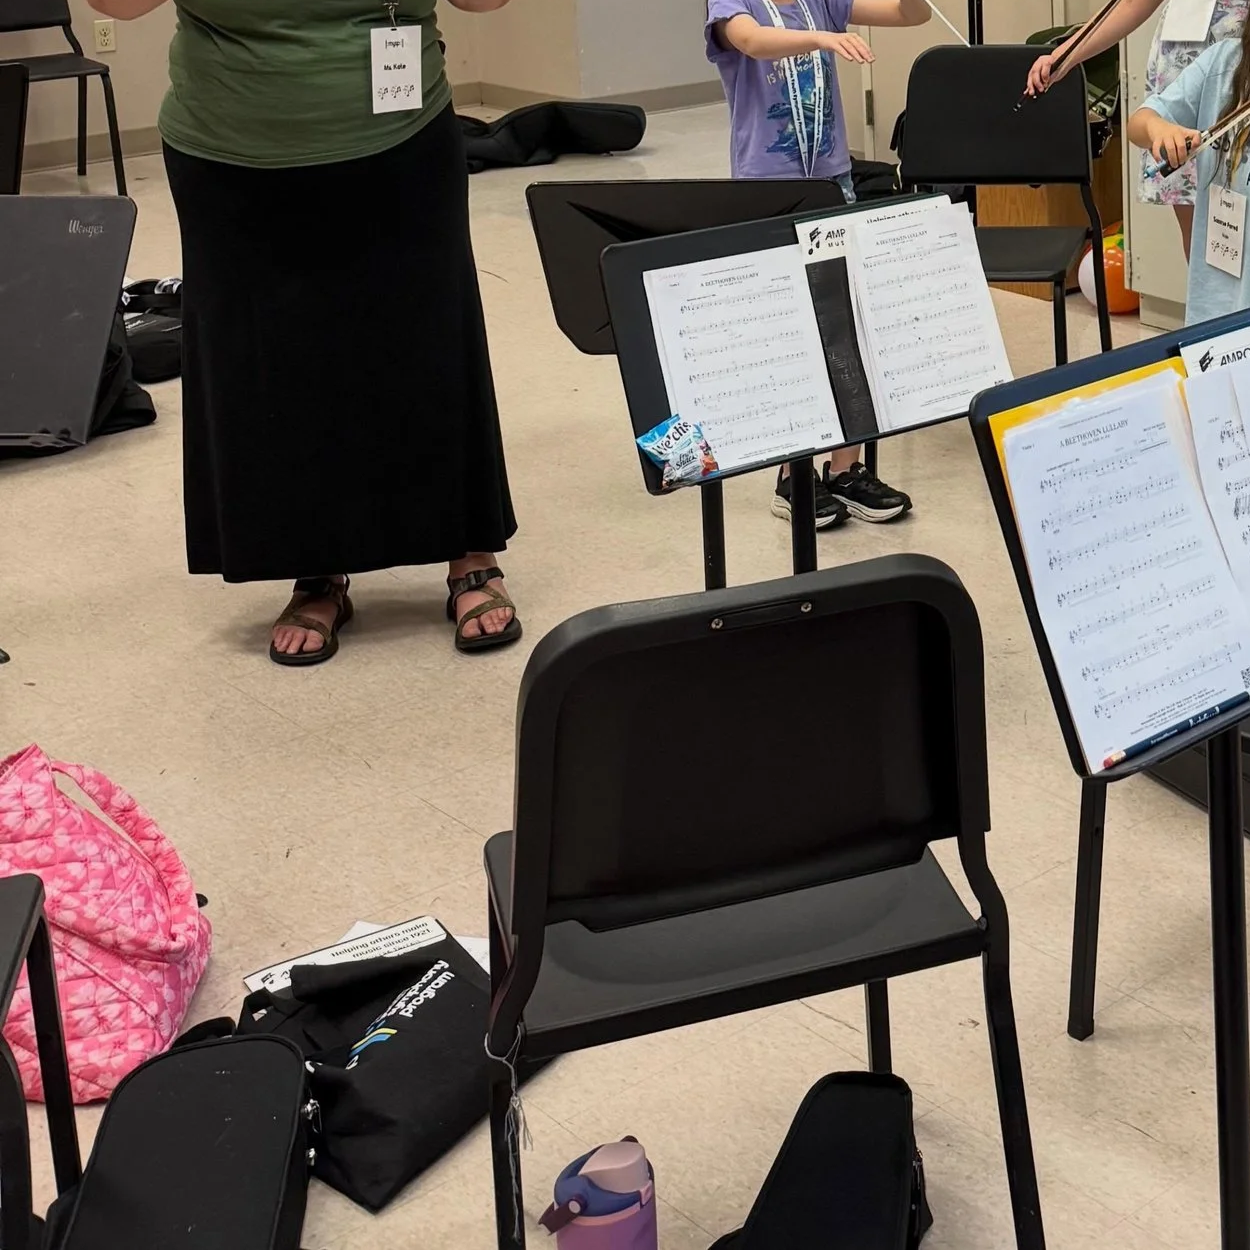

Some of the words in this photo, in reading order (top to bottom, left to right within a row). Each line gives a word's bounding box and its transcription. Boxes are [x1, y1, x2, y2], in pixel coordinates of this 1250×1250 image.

[69, 219, 104, 237] Wenger
[1065, 429, 1101, 447] BEETHOVEN
[1102, 419, 1128, 434] LULLABY
[330, 942, 368, 958] Helping
[370, 933, 400, 945] others
[402, 922, 428, 934] make
[353, 947, 382, 958] music
[384, 938, 409, 948] since
[399, 971, 455, 1018] program
